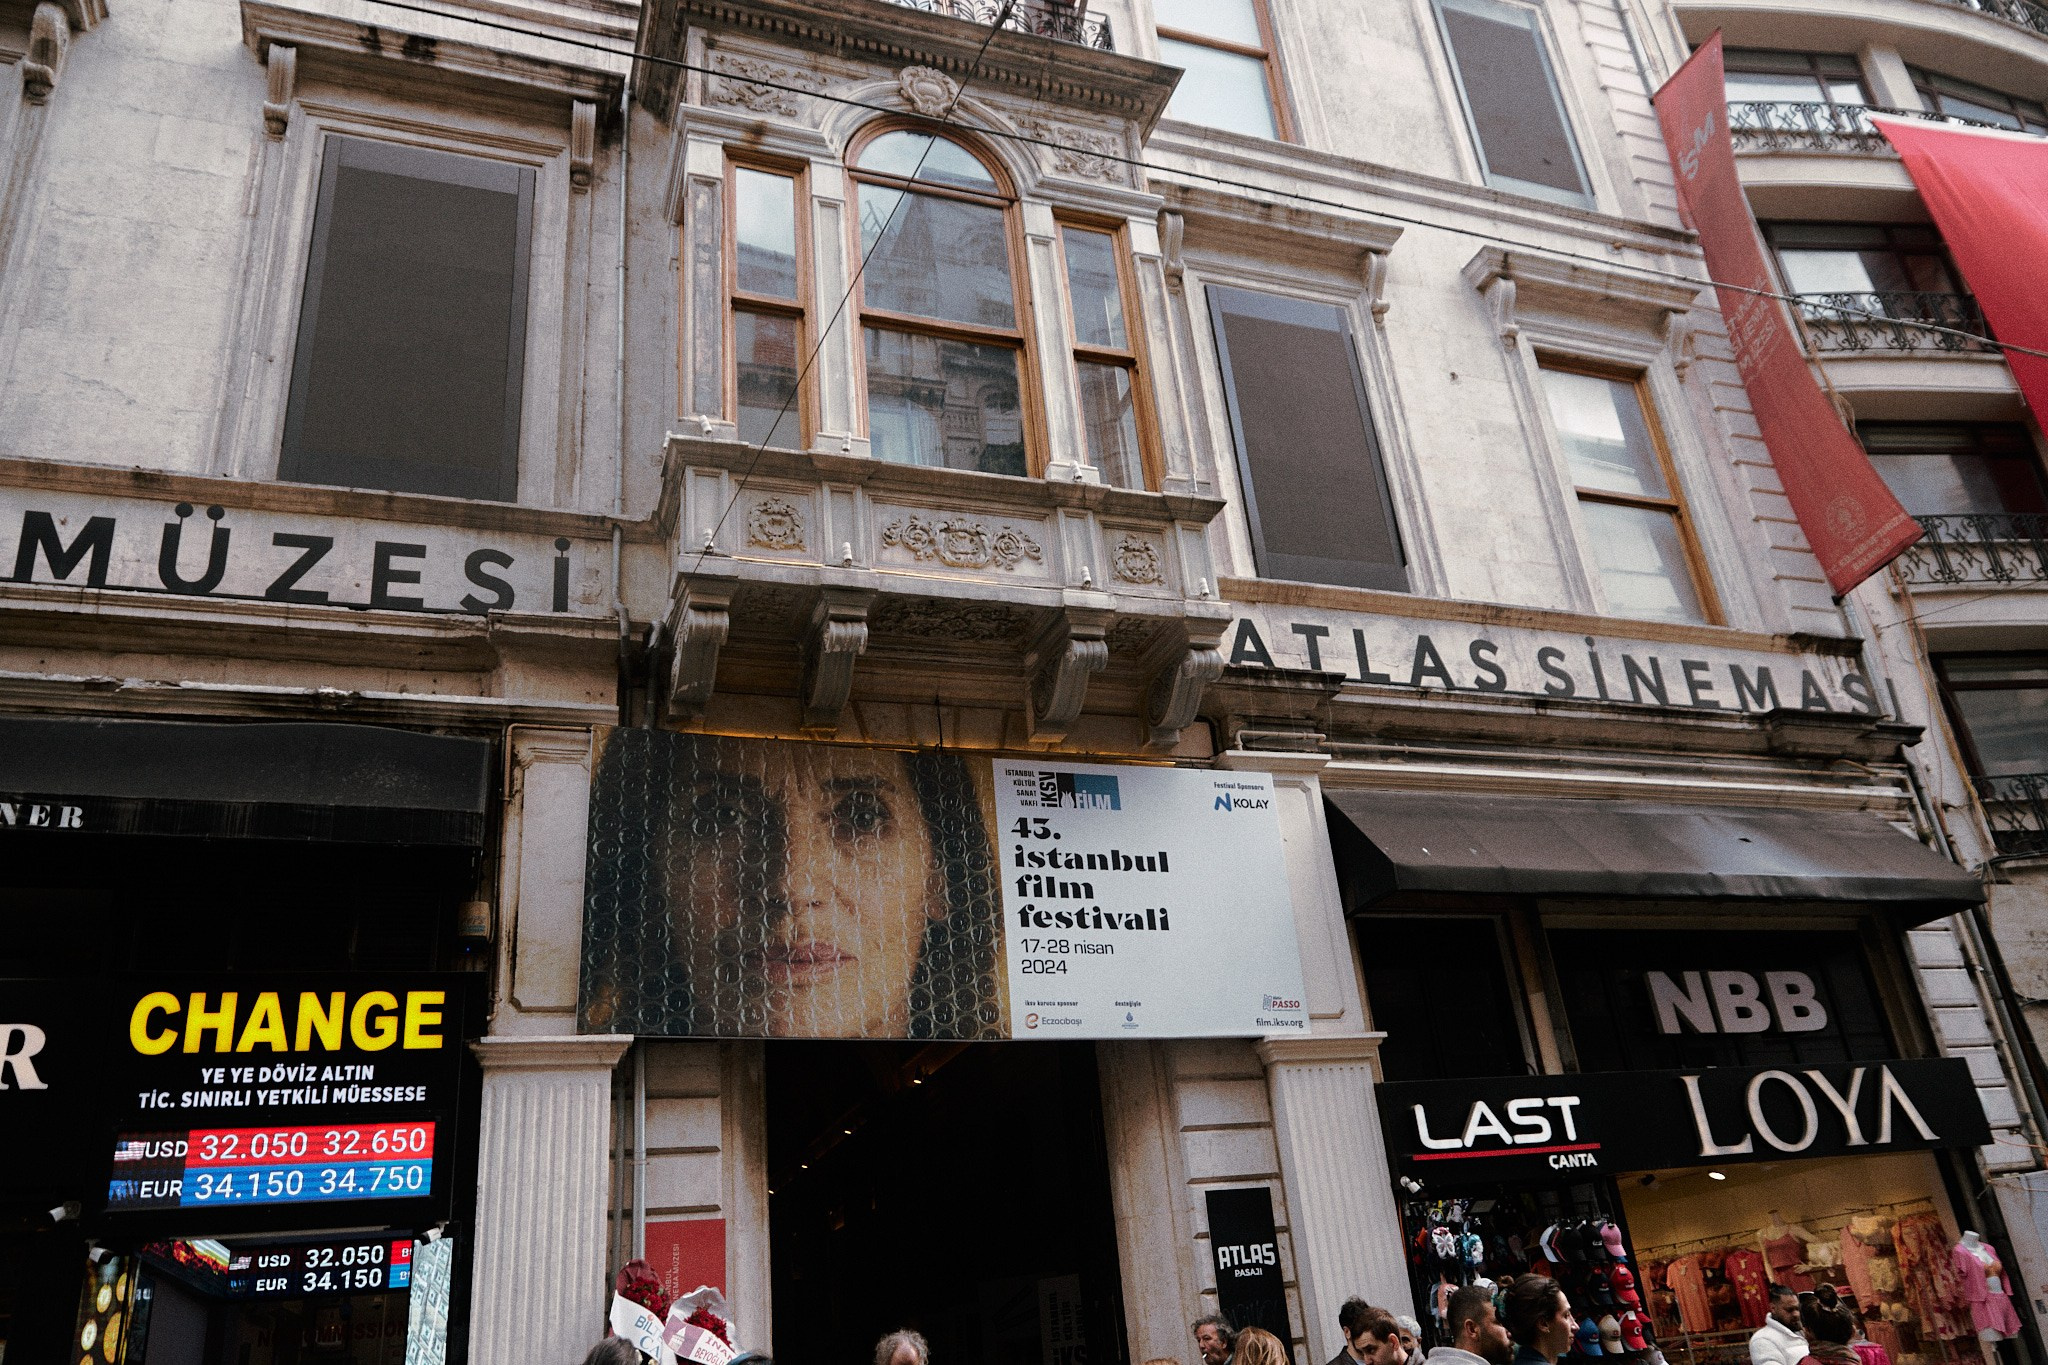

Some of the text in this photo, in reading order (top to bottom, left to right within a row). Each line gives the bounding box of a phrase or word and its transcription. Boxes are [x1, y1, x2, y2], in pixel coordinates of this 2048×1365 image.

[13, 502, 571, 613] MÜZESİ
[1229, 618, 1507, 693] ATLAS
[1016, 789, 1037, 797] SANAT
[1214, 782, 1236, 790] Festival
[1010, 817, 1062, 840] 43.
[1014, 844, 1170, 873] istanbul
[1015, 874, 1095, 900] film
[1017, 904, 1170, 931] festivali
[1021, 938, 1115, 955] 17-28 nisan
[1021, 959, 1068, 975] 2024
[1272, 1000, 1301, 1008] PASSO
[1644, 970, 1828, 1034] NBB
[129, 990, 446, 1056] CHANGE
[1256, 1018, 1304, 1028] film.iksv.org
[201, 1063, 375, 1084] YE YE DÖVİZ ALTIN
[138, 1084, 427, 1109] TİC. SINIRLI YETKİLİ MÜESSESE
[1413, 1096, 1581, 1150] LAST
[143, 1127, 427, 1161] USD 32.050 32.650
[1548, 1153, 1598, 1170] ÇANTA
[139, 1165, 424, 1200] EUR 34.150 34.750
[258, 1255, 291, 1268] USD
[304, 1245, 385, 1269] 32.050
[1217, 1243, 1276, 1270] ATLAS
[256, 1278, 288, 1291] EUR
[302, 1268, 383, 1292] 34.150
